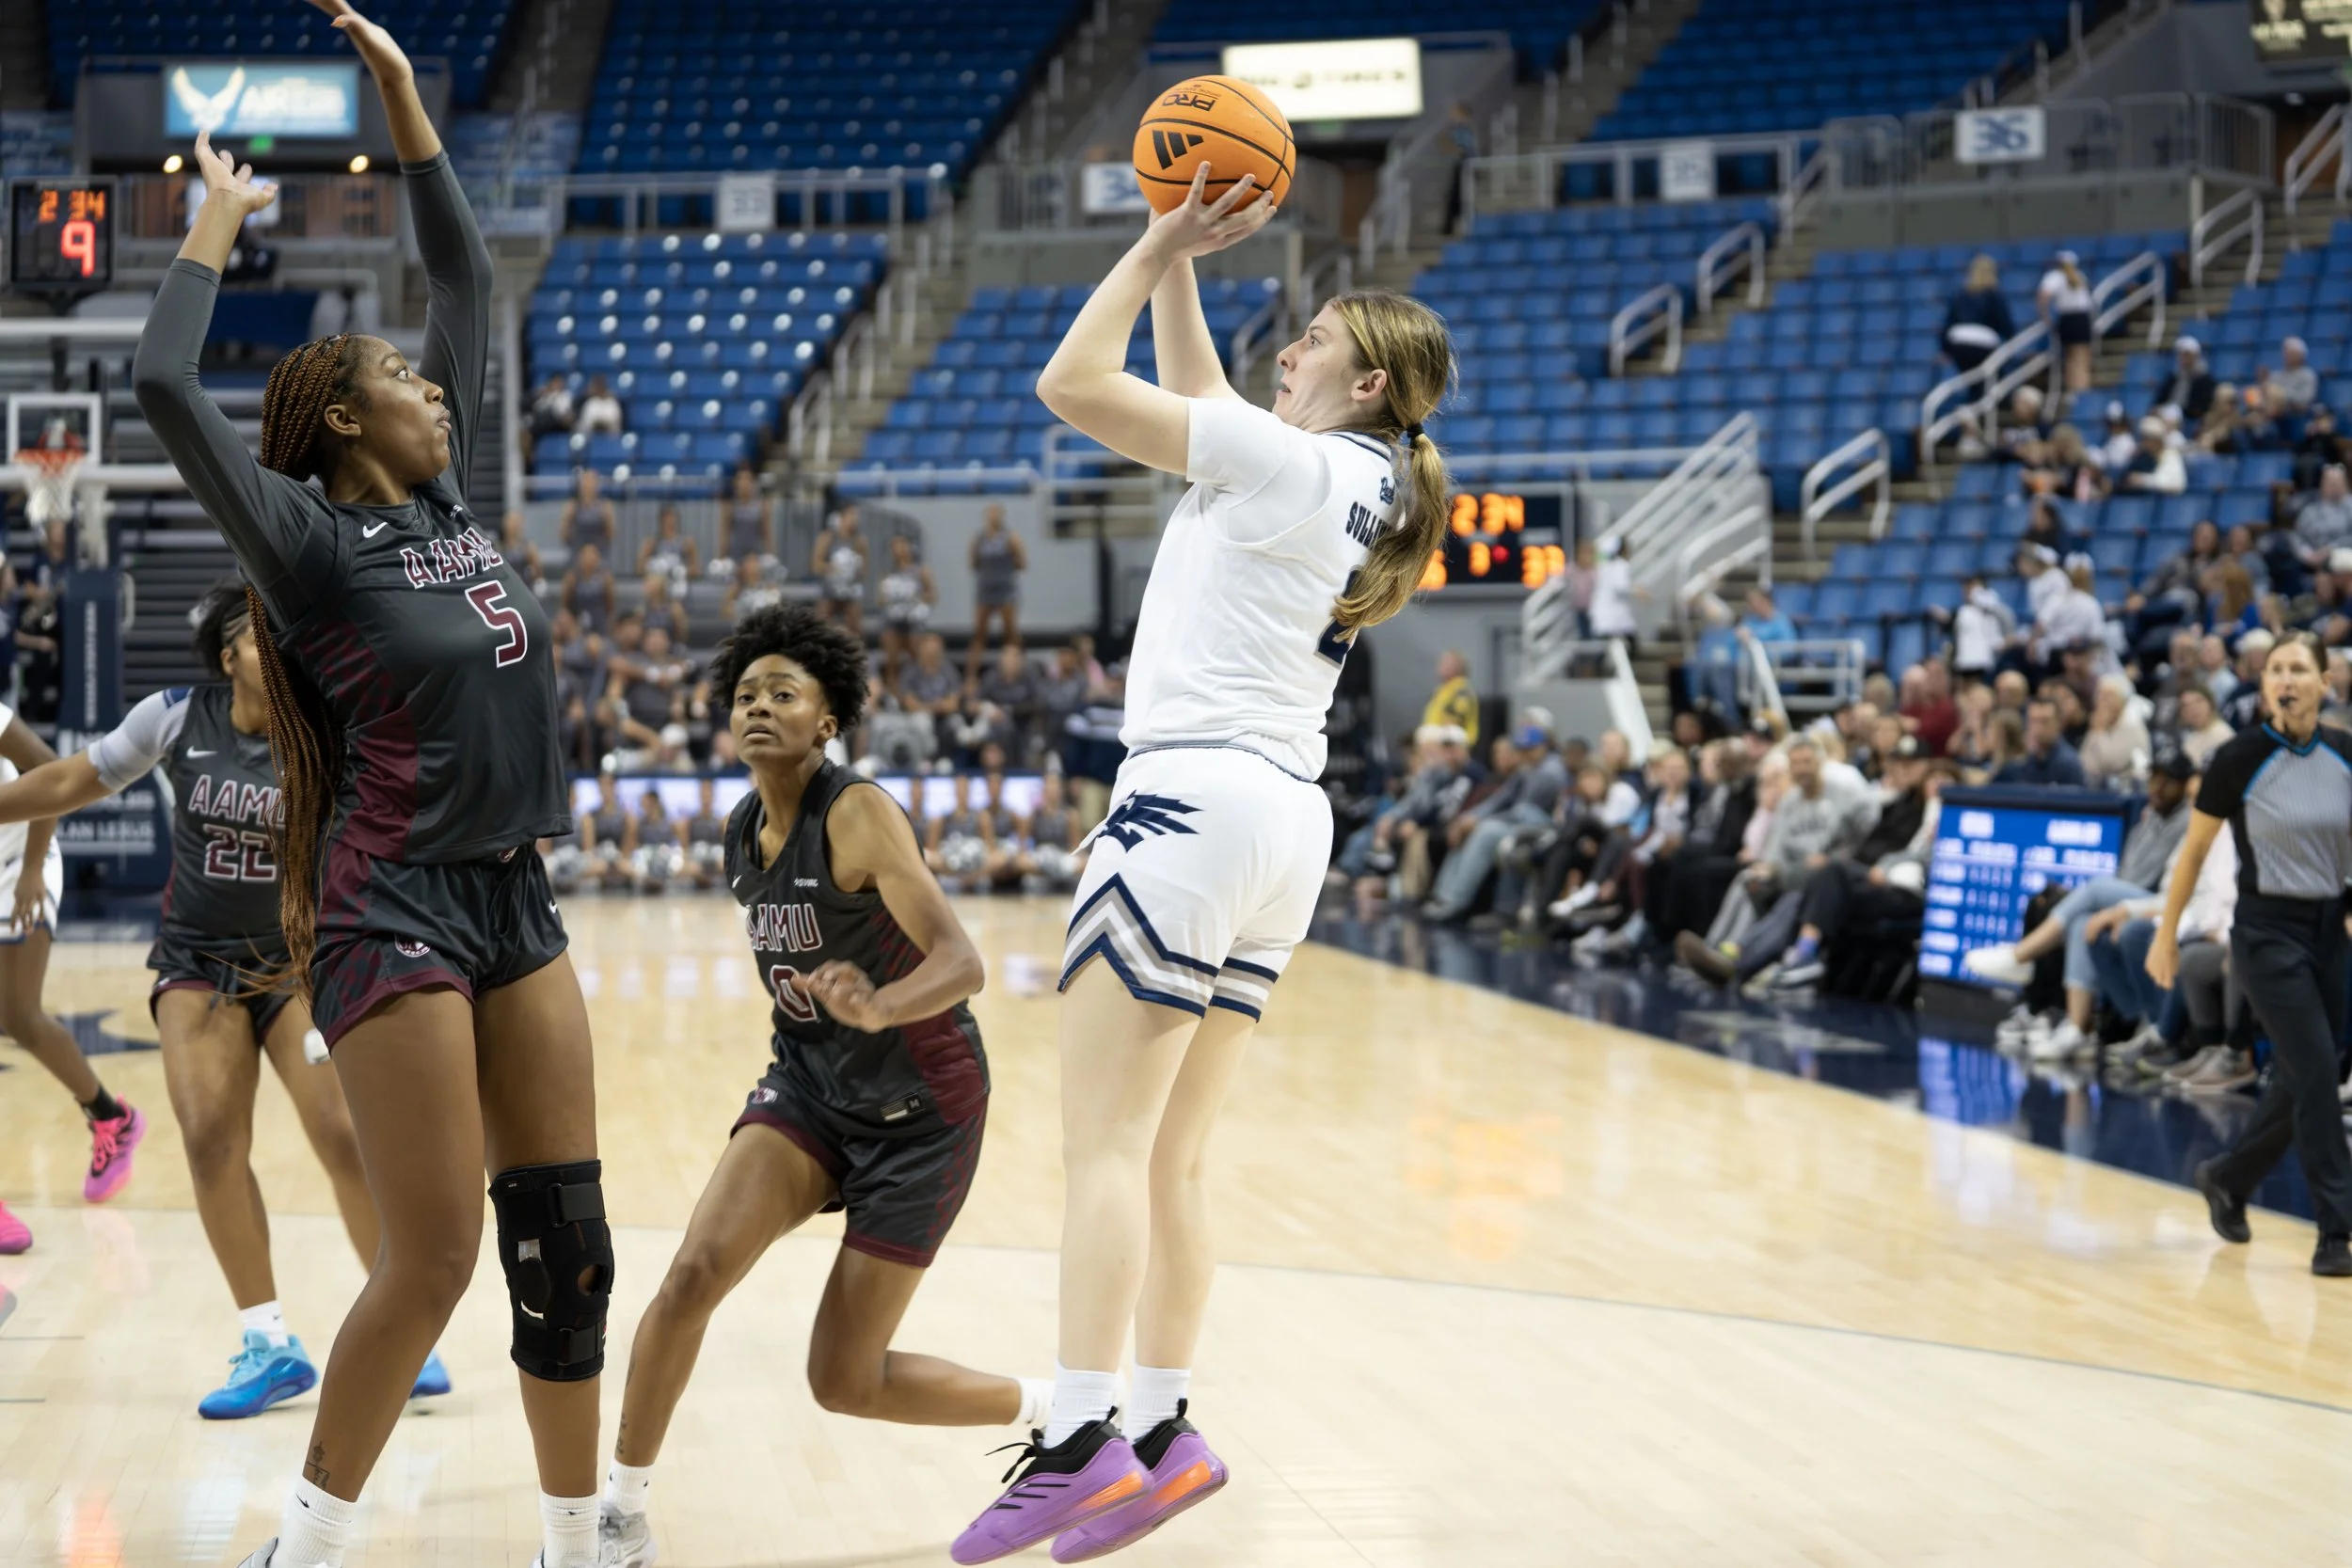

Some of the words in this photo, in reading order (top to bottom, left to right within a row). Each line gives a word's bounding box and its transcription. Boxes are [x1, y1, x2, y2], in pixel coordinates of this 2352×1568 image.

[1162, 93, 1216, 112] PRO
[1974, 115, 2029, 153] 36
[61, 219, 95, 277] 9
[1345, 500, 1391, 551] SULLI
[400, 526, 503, 590] AAMU
[465, 579, 528, 668] 5
[202, 823, 277, 881] 22
